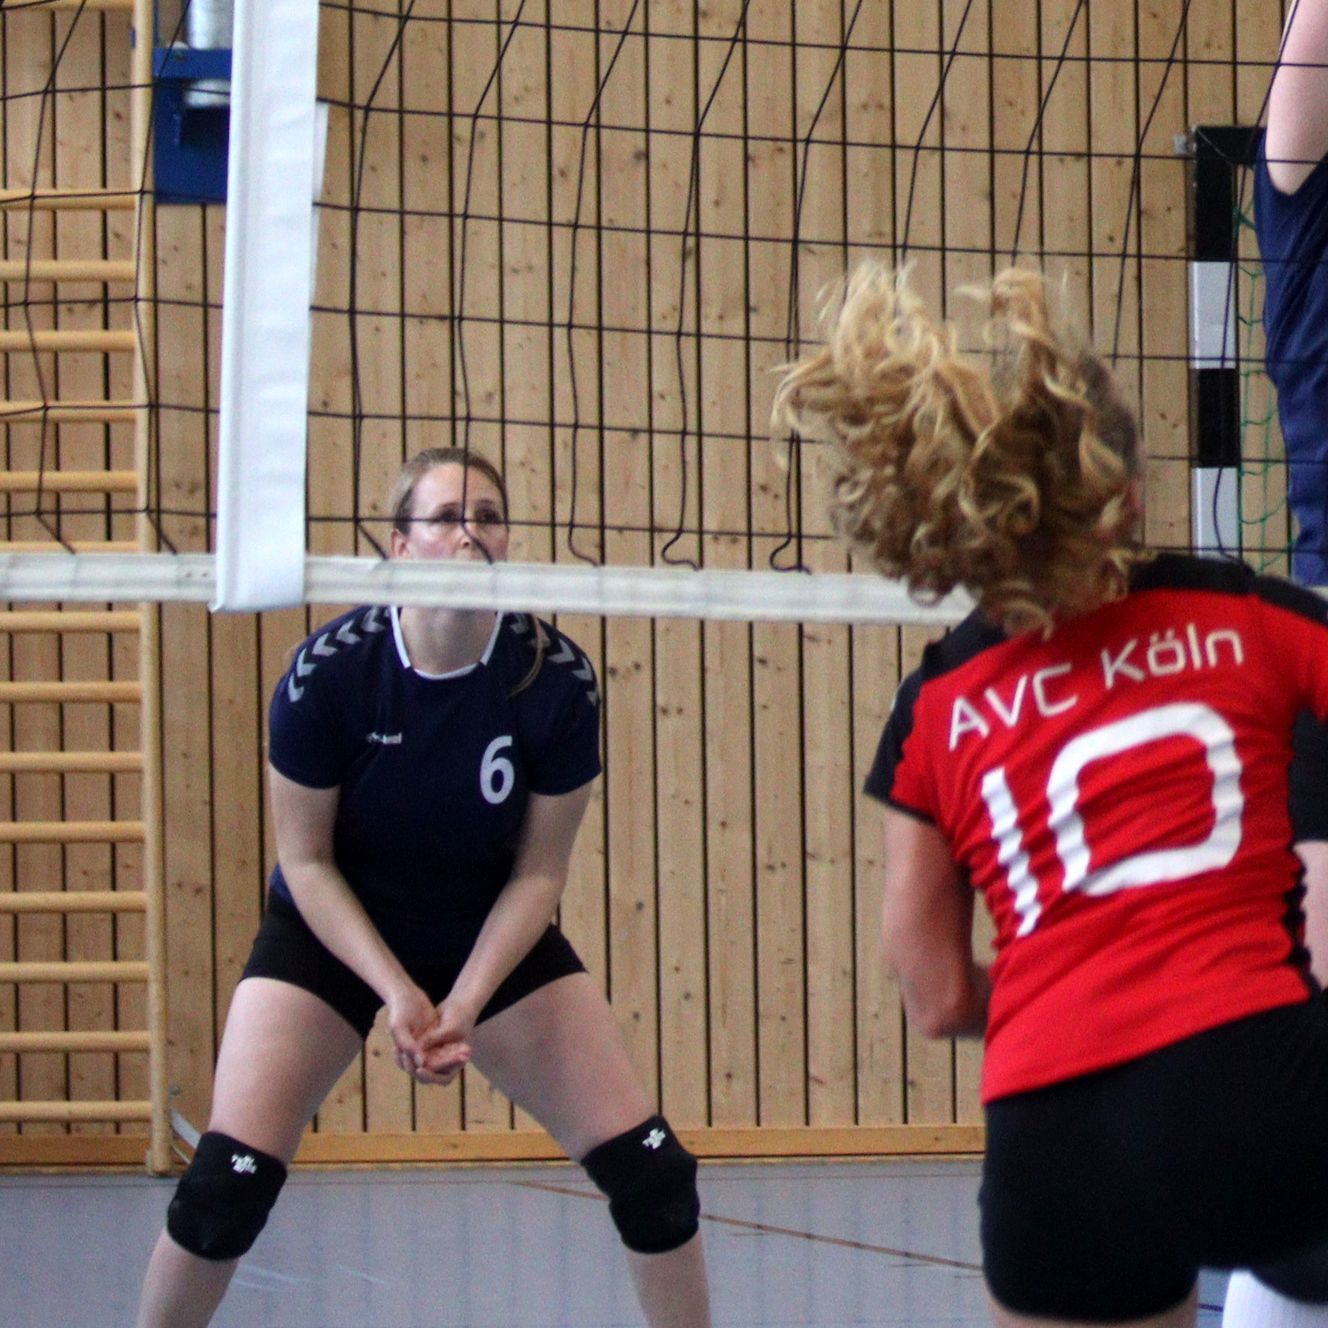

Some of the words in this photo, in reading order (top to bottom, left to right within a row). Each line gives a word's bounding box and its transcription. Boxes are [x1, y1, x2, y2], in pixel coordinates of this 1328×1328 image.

[947, 663, 1078, 752] AVC
[1101, 623, 1244, 690] Köln
[479, 735, 515, 804] 6
[981, 701, 1243, 937] 10
